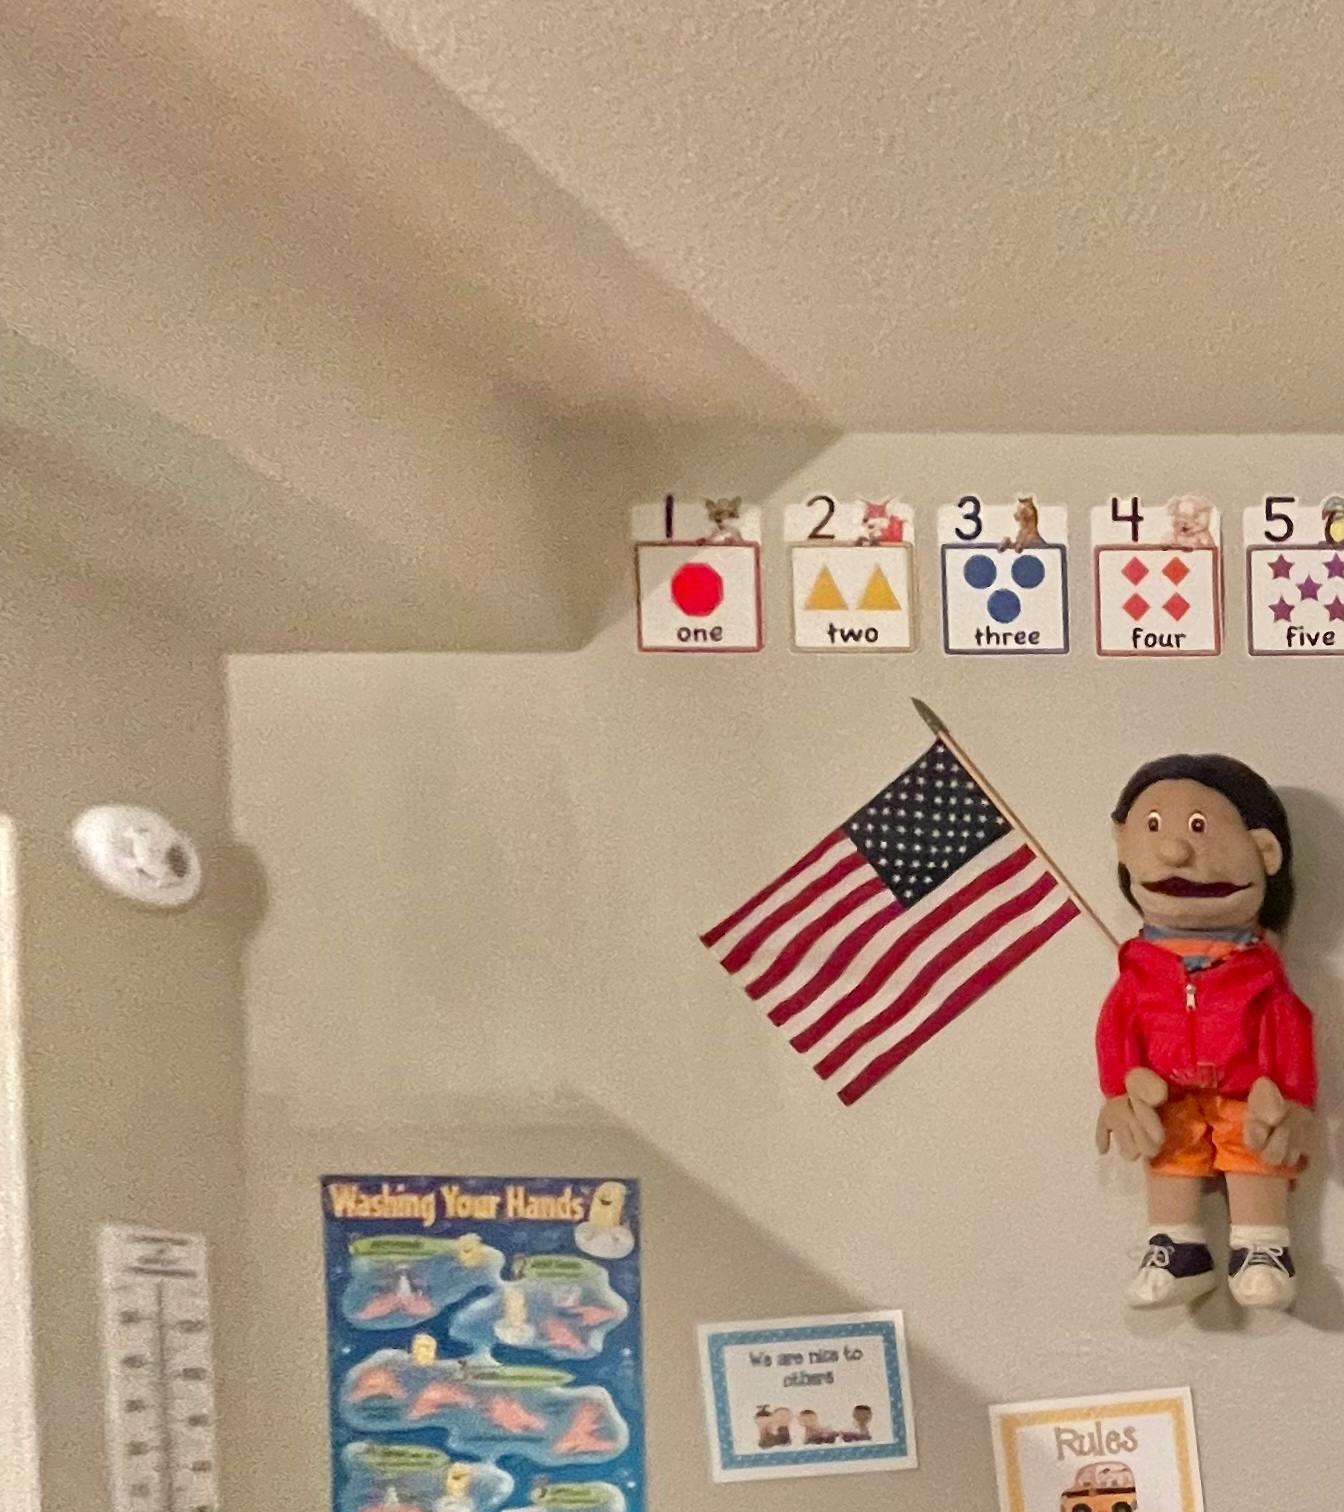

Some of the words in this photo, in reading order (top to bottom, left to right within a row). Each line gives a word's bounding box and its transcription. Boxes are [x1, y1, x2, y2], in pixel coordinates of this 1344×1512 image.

[664, 495, 674, 538] 1
[806, 496, 837, 539] 2
[954, 496, 983, 540] 3
[1111, 498, 1145, 542] 4
[1263, 496, 1295, 542] 5
[676, 624, 723, 644] one
[826, 622, 879, 644] two
[974, 625, 1041, 646] three
[1131, 628, 1187, 650] four
[1286, 626, 1336, 648] five
[328, 1182, 436, 1226] Washing
[441, 1185, 500, 1221] Your
[506, 1184, 585, 1222] Hands
[750, 1351, 772, 1367] We
[777, 1352, 804, 1366] are
[808, 1348, 839, 1364] nice
[843, 1346, 863, 1361] to
[783, 1371, 834, 1388] others
[1054, 1421, 1138, 1461] Rules
